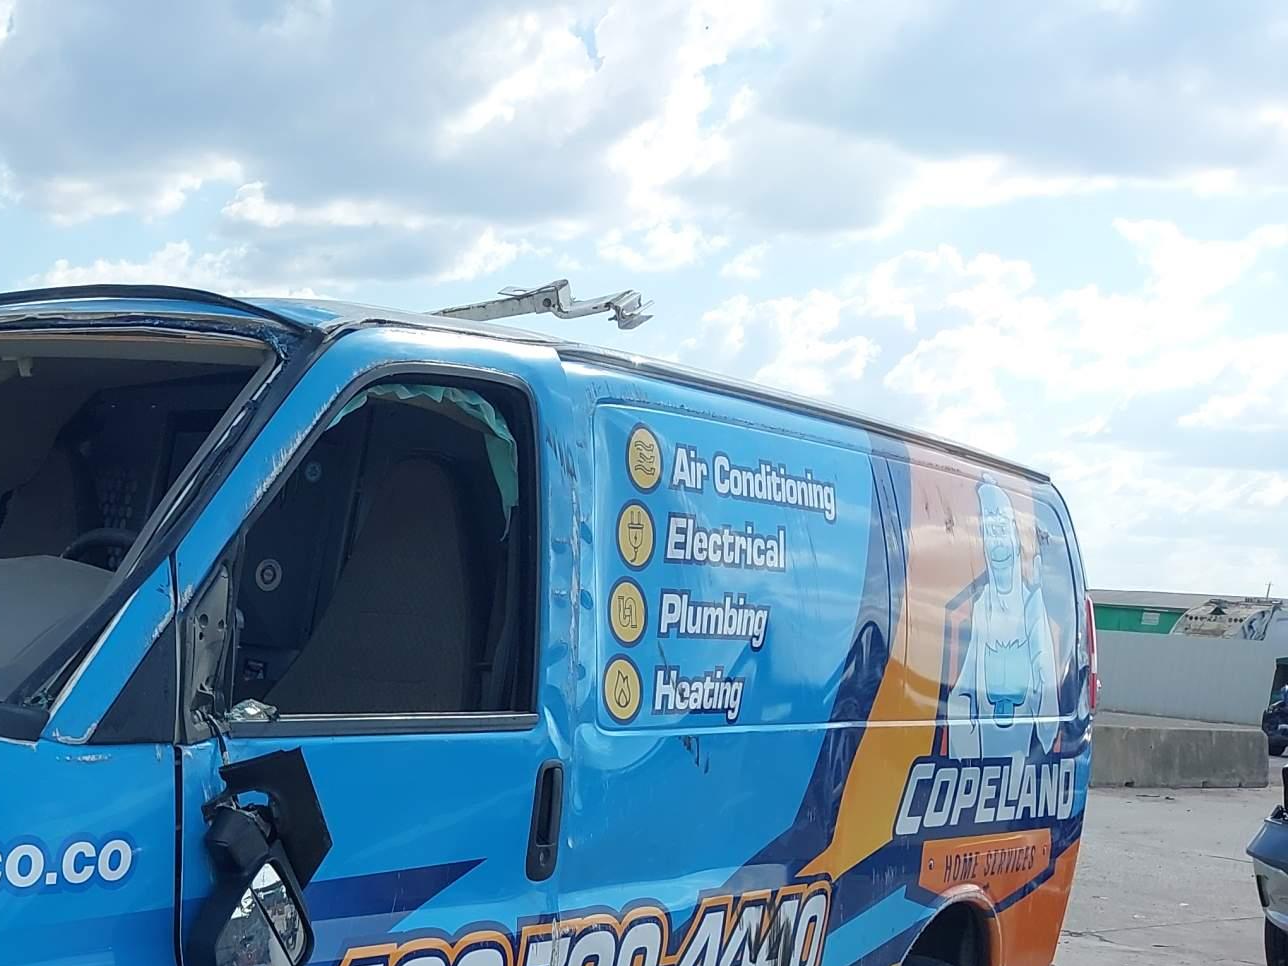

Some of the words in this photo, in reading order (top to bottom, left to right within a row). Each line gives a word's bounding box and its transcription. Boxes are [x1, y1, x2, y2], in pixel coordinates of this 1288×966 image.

[672, 447, 708, 489] Air
[714, 455, 835, 520] Conditioning
[665, 516, 785, 568] Electrical
[660, 594, 768, 647] Plumbing
[654, 669, 744, 720] Heating
[895, 758, 1075, 835] COPELAND
[943, 851, 981, 883] HOME
[983, 845, 1036, 877] SERVICES
